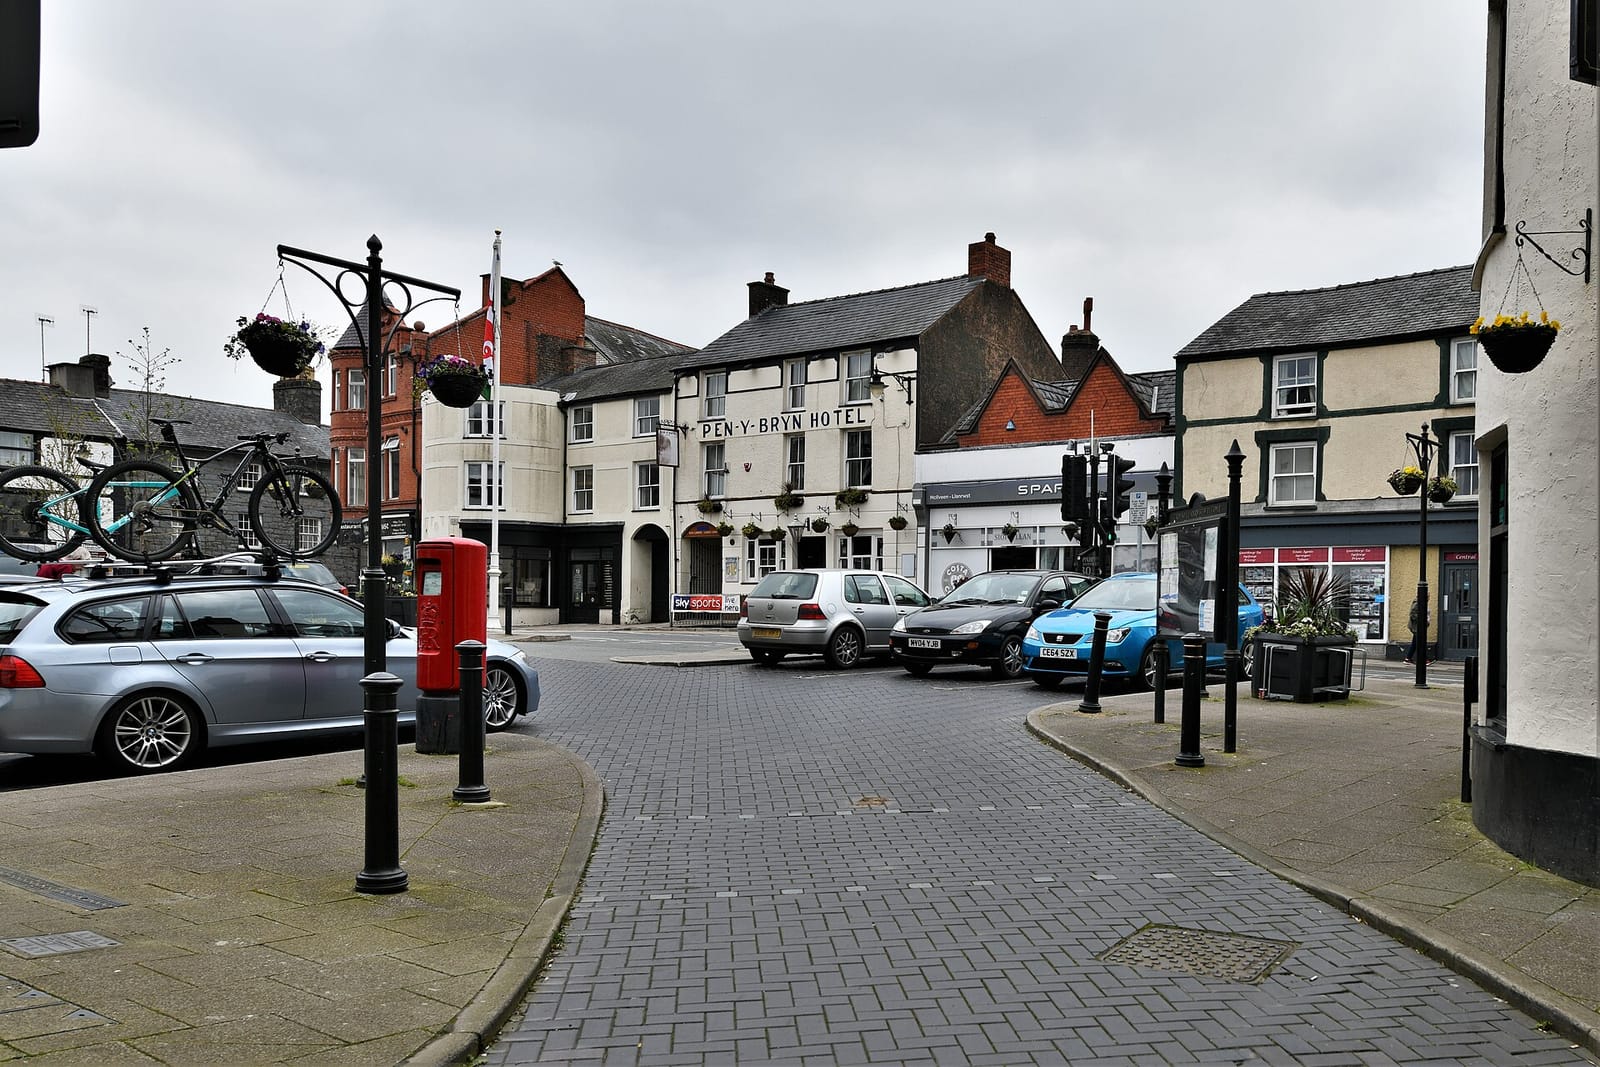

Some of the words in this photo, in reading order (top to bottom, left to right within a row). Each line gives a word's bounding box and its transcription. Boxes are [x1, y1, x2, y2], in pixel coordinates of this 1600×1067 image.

[702, 414, 802, 438] PEN-Y-BRYN
[810, 407, 866, 428] HOTEL
[946, 564, 968, 576] COSTA
[675, 597, 690, 609] sky
[691, 598, 721, 609] sports
[1042, 648, 1059, 657] CE64
[1060, 649, 1075, 658] SZX
